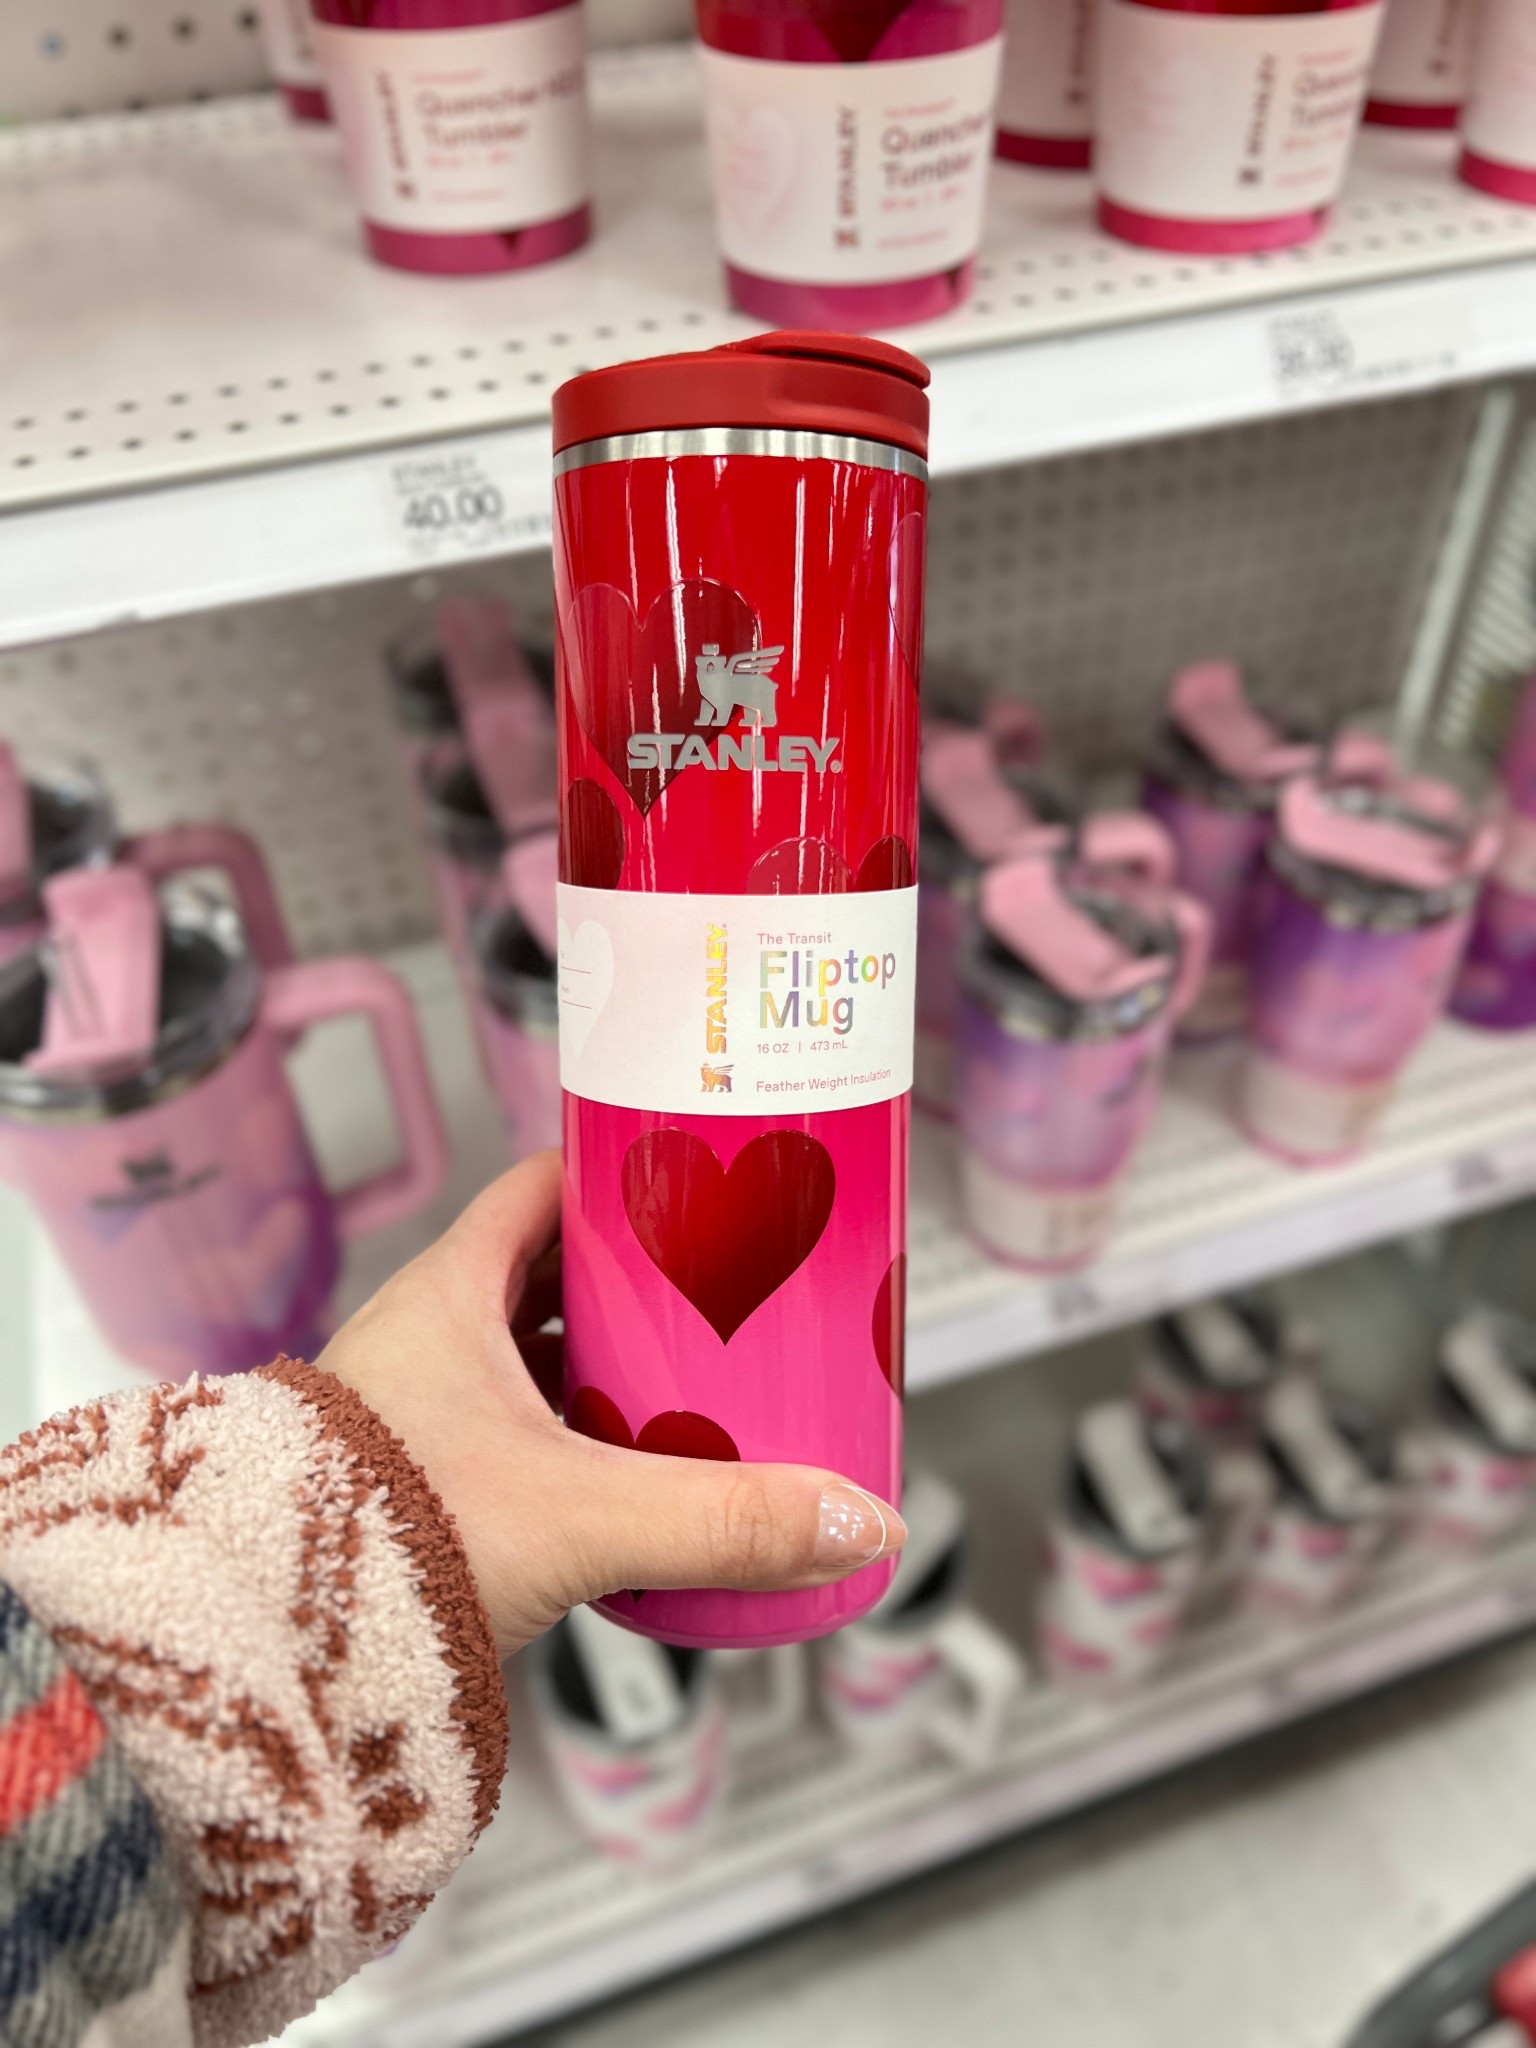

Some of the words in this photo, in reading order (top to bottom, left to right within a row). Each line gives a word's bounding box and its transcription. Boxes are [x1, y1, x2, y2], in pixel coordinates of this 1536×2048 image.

[402, 483, 504, 530] 40.00
[627, 733, 842, 773] STANLEY
[756, 932, 783, 945] The
[787, 931, 832, 944] Transit
[706, 923, 728, 1054] STANLEY
[760, 949, 896, 997] Fliptop
[760, 991, 854, 1035] Mug
[756, 1043, 770, 1054] 16
[772, 1042, 789, 1054] OZ
[809, 1040, 830, 1051] 473
[832, 1039, 848, 1049] mL
[756, 1080, 805, 1092] Feather
[808, 1076, 848, 1091] Weight
[850, 1068, 891, 1084] Insulation
